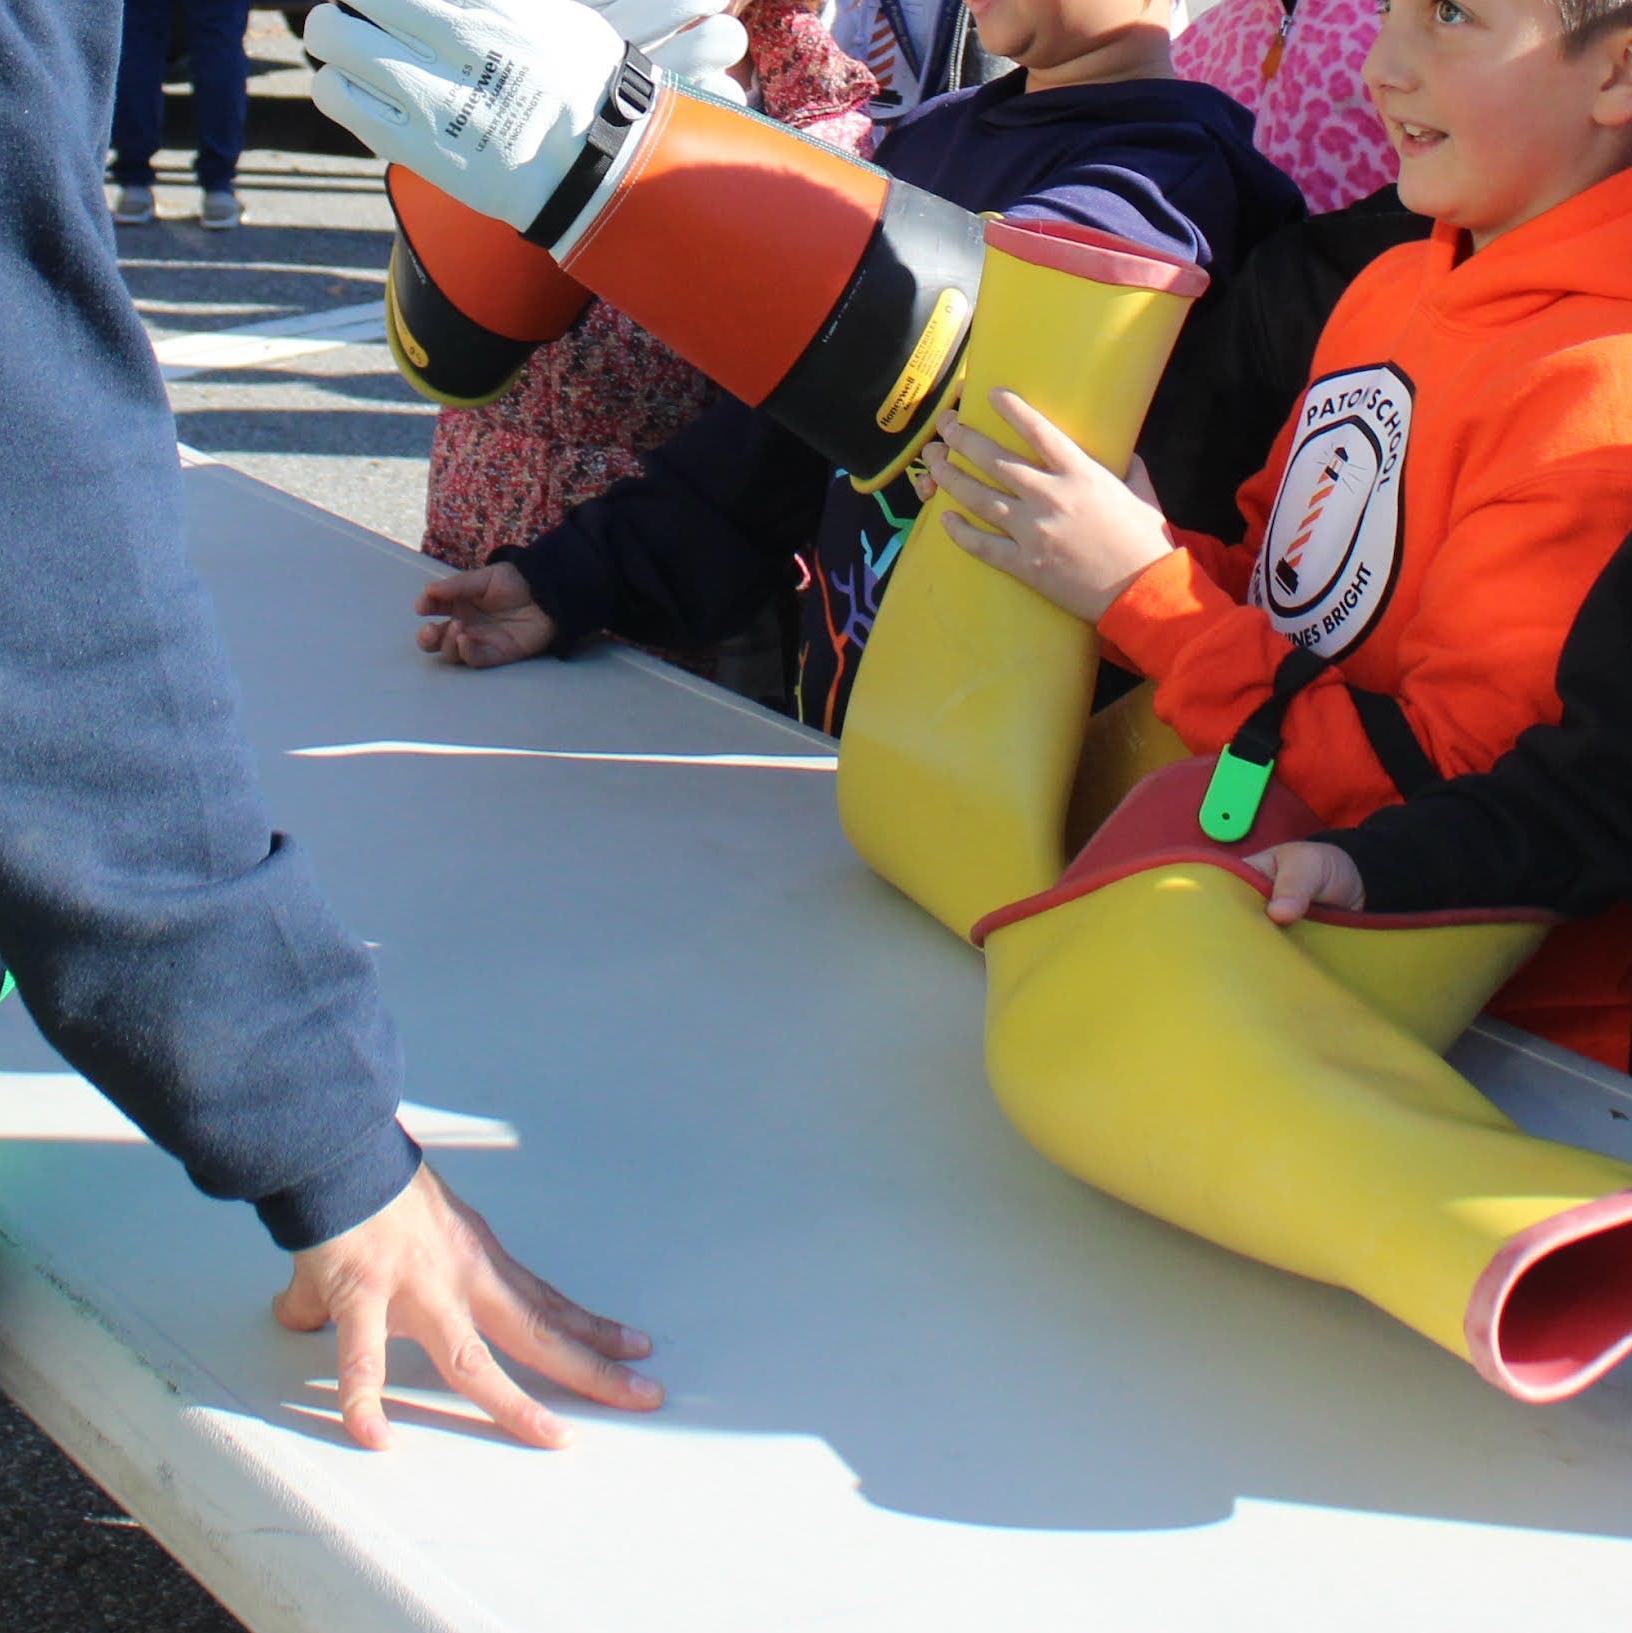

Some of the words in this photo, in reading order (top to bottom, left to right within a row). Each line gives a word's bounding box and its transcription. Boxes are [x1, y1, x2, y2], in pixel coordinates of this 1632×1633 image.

[445, 50, 503, 139] Honeywell
[475, 116, 500, 152] LEATHER
[496, 65, 530, 118] PROTECTORS
[484, 60, 515, 109] SALISBURY
[880, 376, 916, 426] Honeywell
[1367, 388, 1401, 491] SCHOOL
[1323, 561, 1372, 635] BRIGHT
